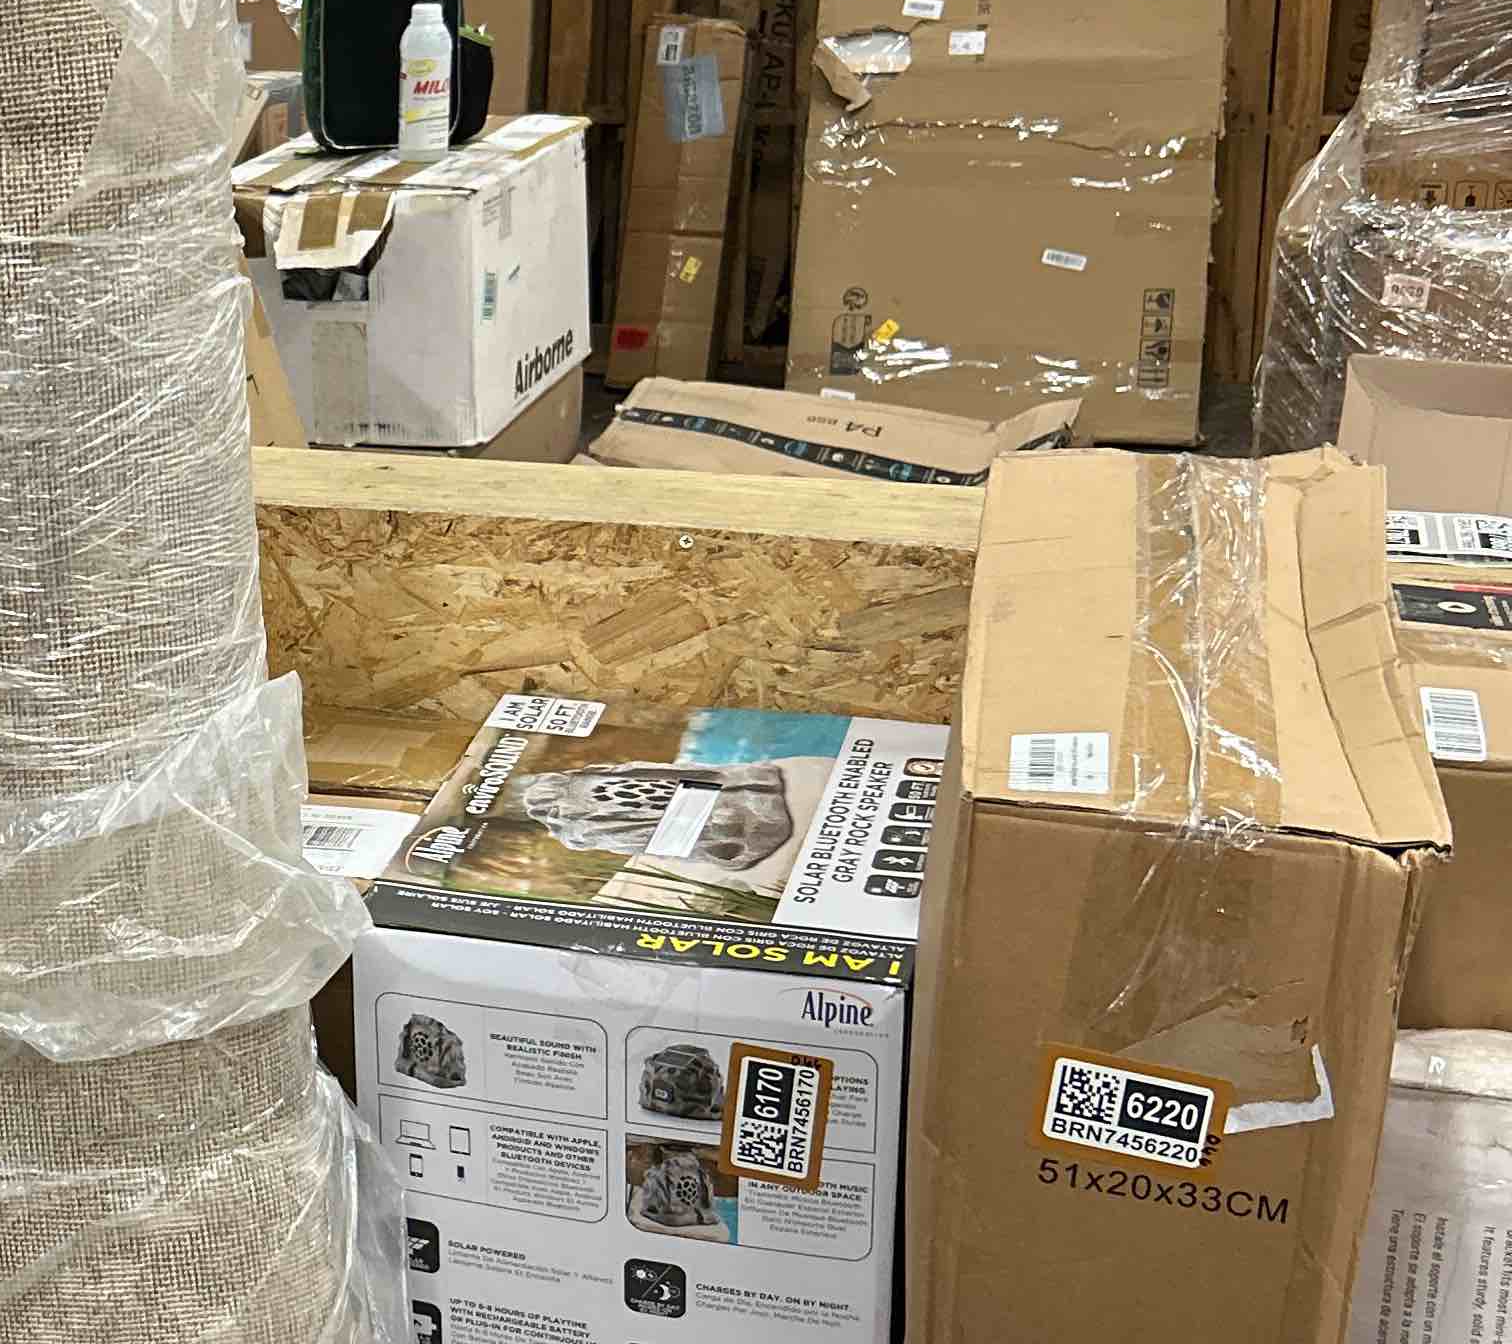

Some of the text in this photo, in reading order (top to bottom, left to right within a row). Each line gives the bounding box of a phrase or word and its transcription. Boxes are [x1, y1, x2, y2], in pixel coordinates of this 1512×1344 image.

[513, 328, 574, 399] Airborne
[505, 701, 523, 717] AM
[516, 697, 549, 730] SOLAR
[546, 718, 569, 731] 50
[465, 735, 529, 815] enviroSOUND
[793, 738, 875, 904] SOLAR BLUETOOTH ENABLED
[831, 761, 895, 883] GRAY ROCK SPEAKER
[412, 825, 471, 864] Alpine
[635, 931, 901, 976] I AM SOLAR
[800, 990, 874, 1028] Alpine
[753, 1067, 784, 1119] 6170
[1125, 1091, 1200, 1132] 6220
[787, 1069, 816, 1173] BRN7456170
[1050, 1115, 1199, 1165] BRN7456220
[1037, 1157, 1290, 1226] 51x20x33CM
[447, 1239, 527, 1261] SOLAR POWERED
[695, 1282, 742, 1298] CHARGES
[449, 1297, 588, 1330] UP HOURS PLAYTIME
[449, 1306, 591, 1340] WITH RECHARGEABLE BATTERY
[502, 1324, 523, 1335] FOR
